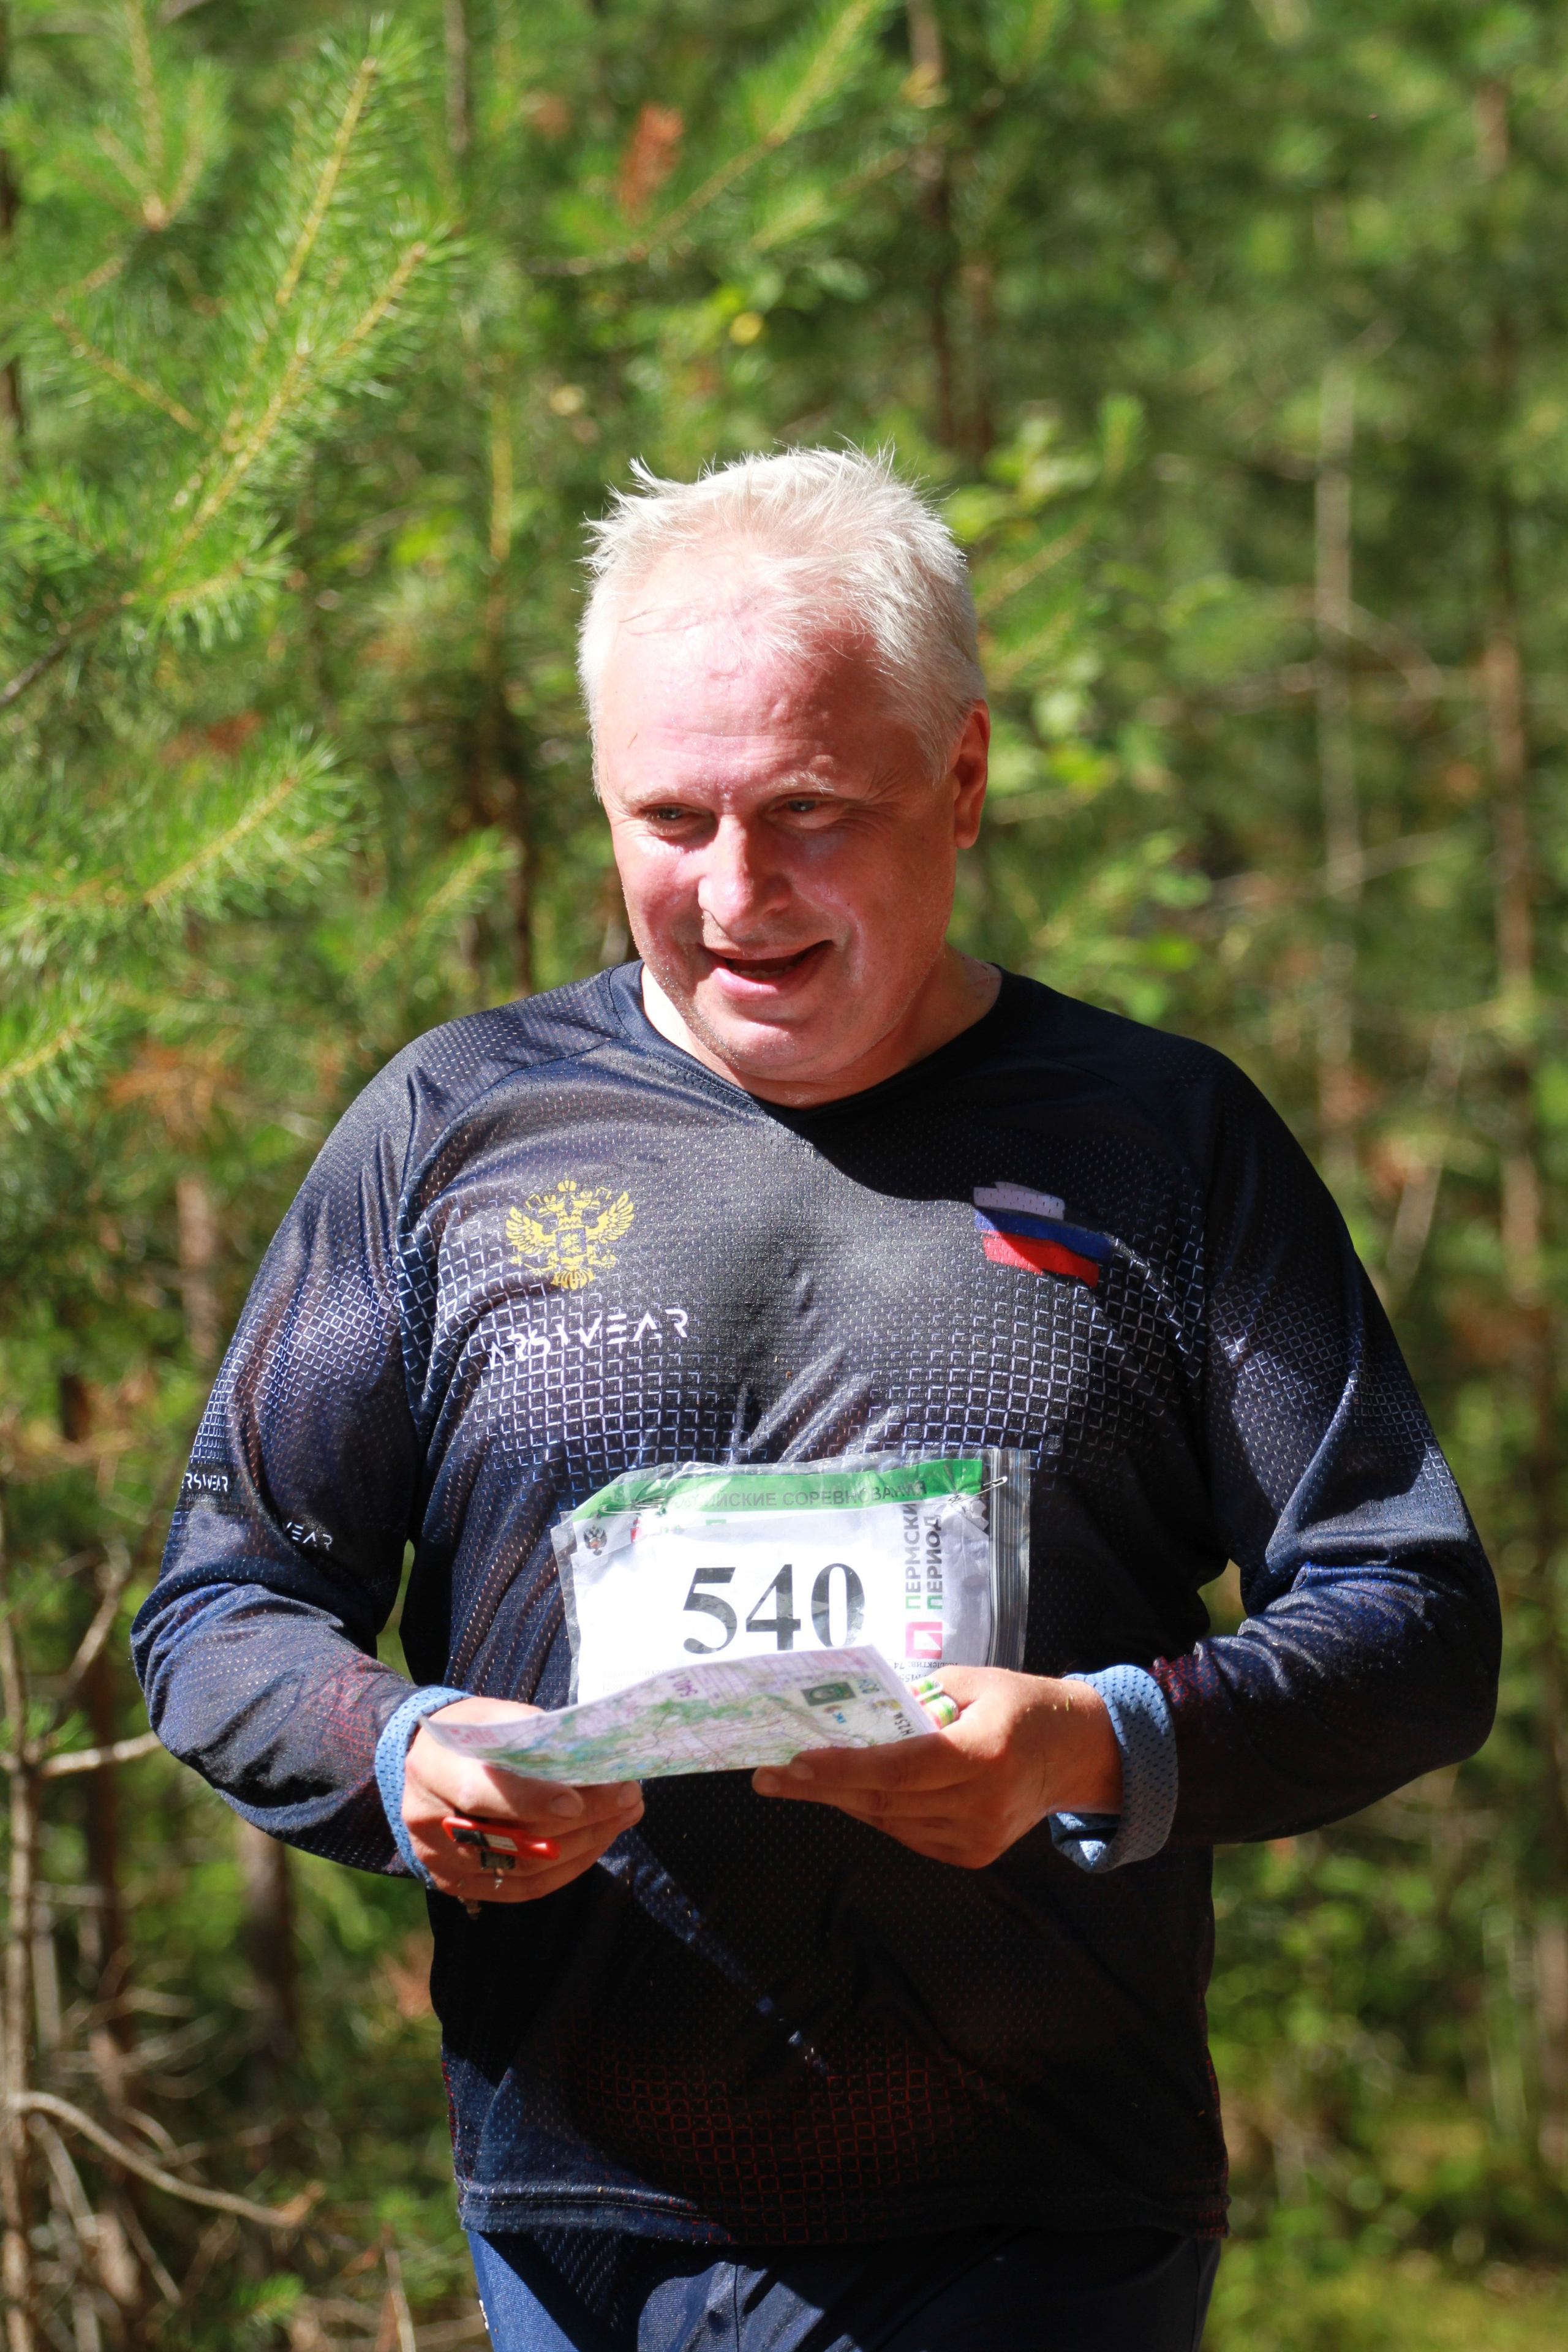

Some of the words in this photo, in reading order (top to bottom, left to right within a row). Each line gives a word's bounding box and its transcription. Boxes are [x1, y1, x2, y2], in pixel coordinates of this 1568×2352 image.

[902, 1503, 921, 1610] ПЕРМСКИ
[924, 1515, 943, 1610] ПЕРИОД
[682, 1562, 865, 1654] 540
